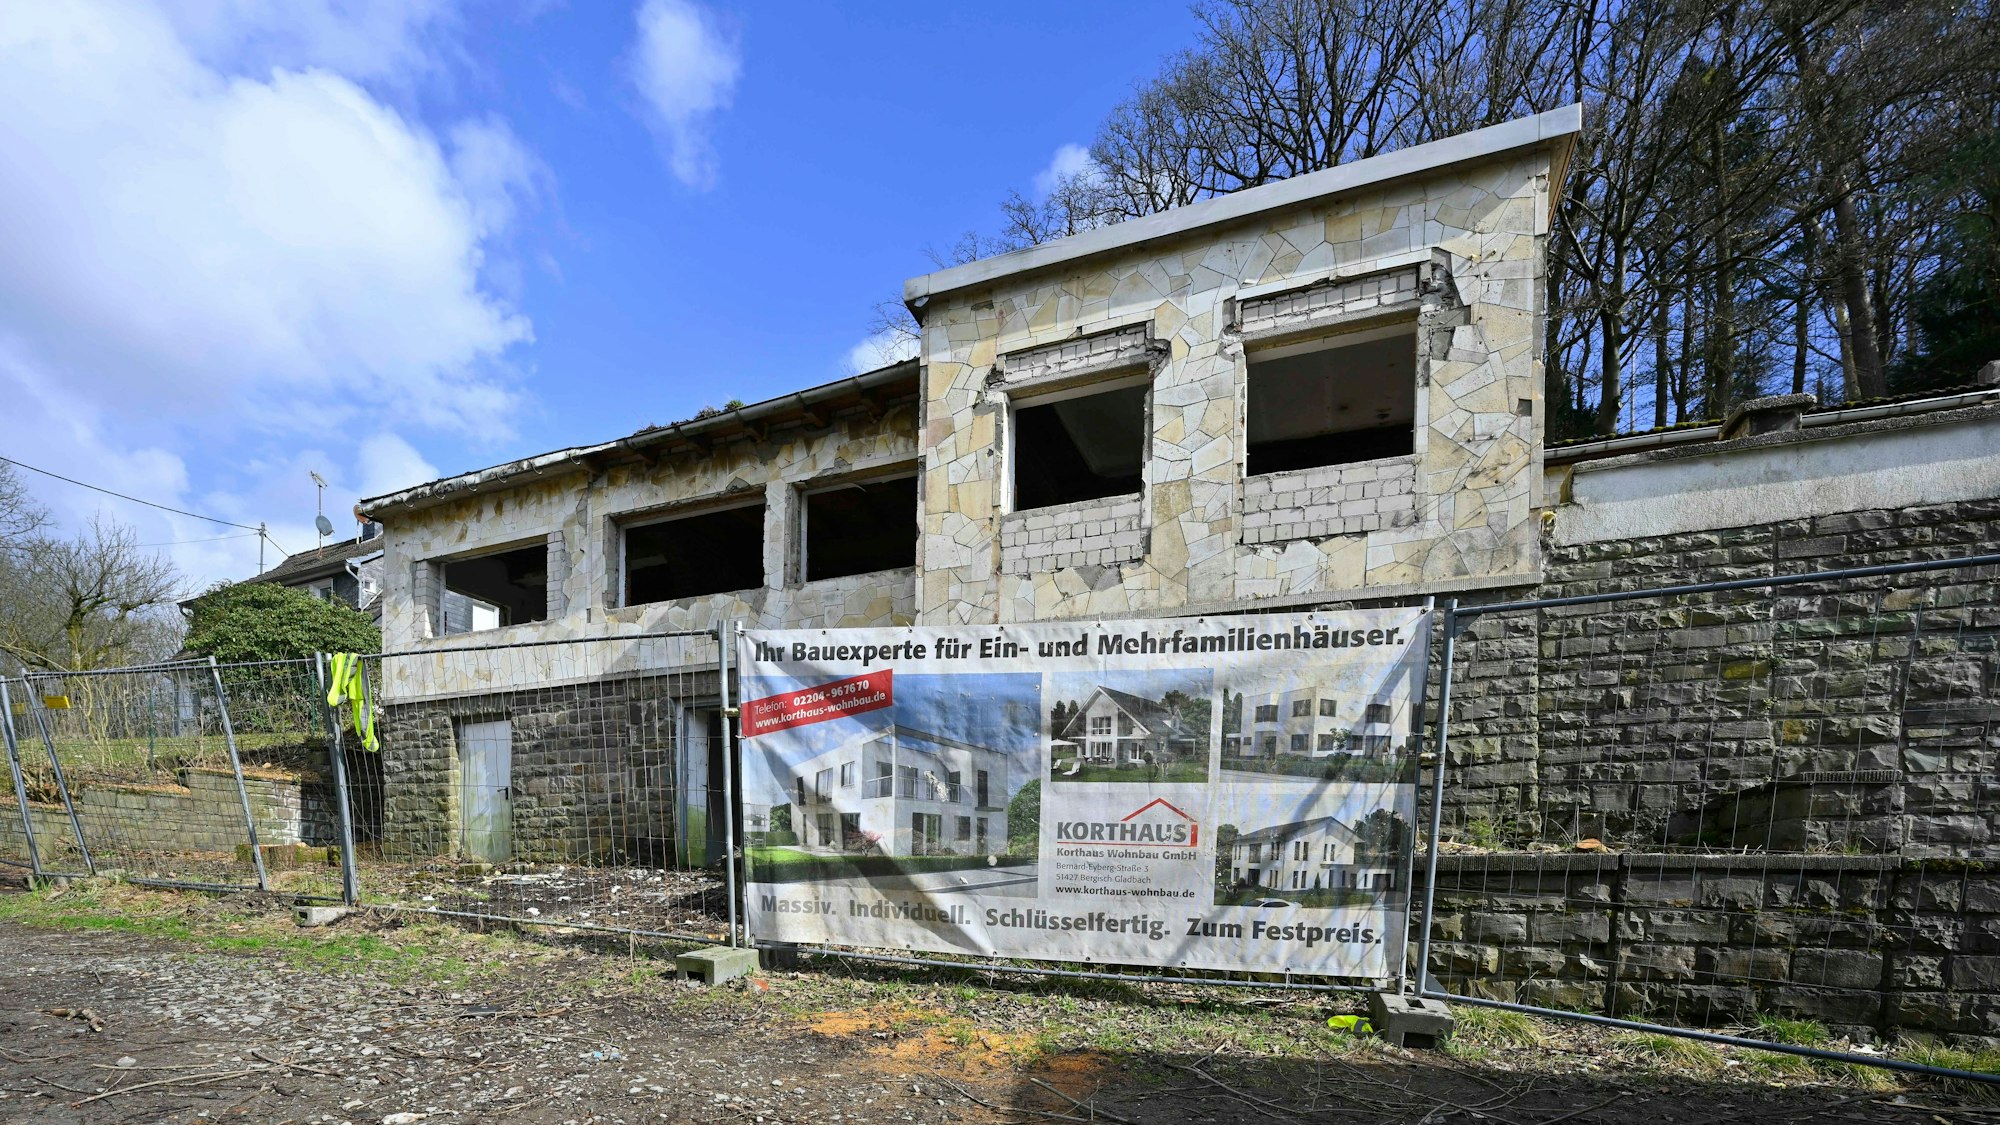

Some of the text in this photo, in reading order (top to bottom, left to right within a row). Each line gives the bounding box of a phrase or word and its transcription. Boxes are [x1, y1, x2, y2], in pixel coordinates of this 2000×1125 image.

[755, 625, 1404, 666] Ihr Bauexperte für Ein- und Mehrfamilienhäuser.
[754, 701, 787, 715] Telefon:
[755, 691, 886, 728] www.korthaus-wohnbau.de
[1057, 821, 1186, 842] KORTHAUS
[1057, 848, 1196, 860] Korthaus Wohnbau GmbH
[1056, 862, 1141, 873] Bernard-Eyberg-Straße
[1080, 874, 1112, 883] Bergisch
[1114, 875, 1151, 884] Gladbach
[1055, 886, 1195, 898] www.korthaus-wohnbau.de
[761, 895, 1382, 948] Massiv. Individuell. Schlüsselfertig. Zum Festpreis.
